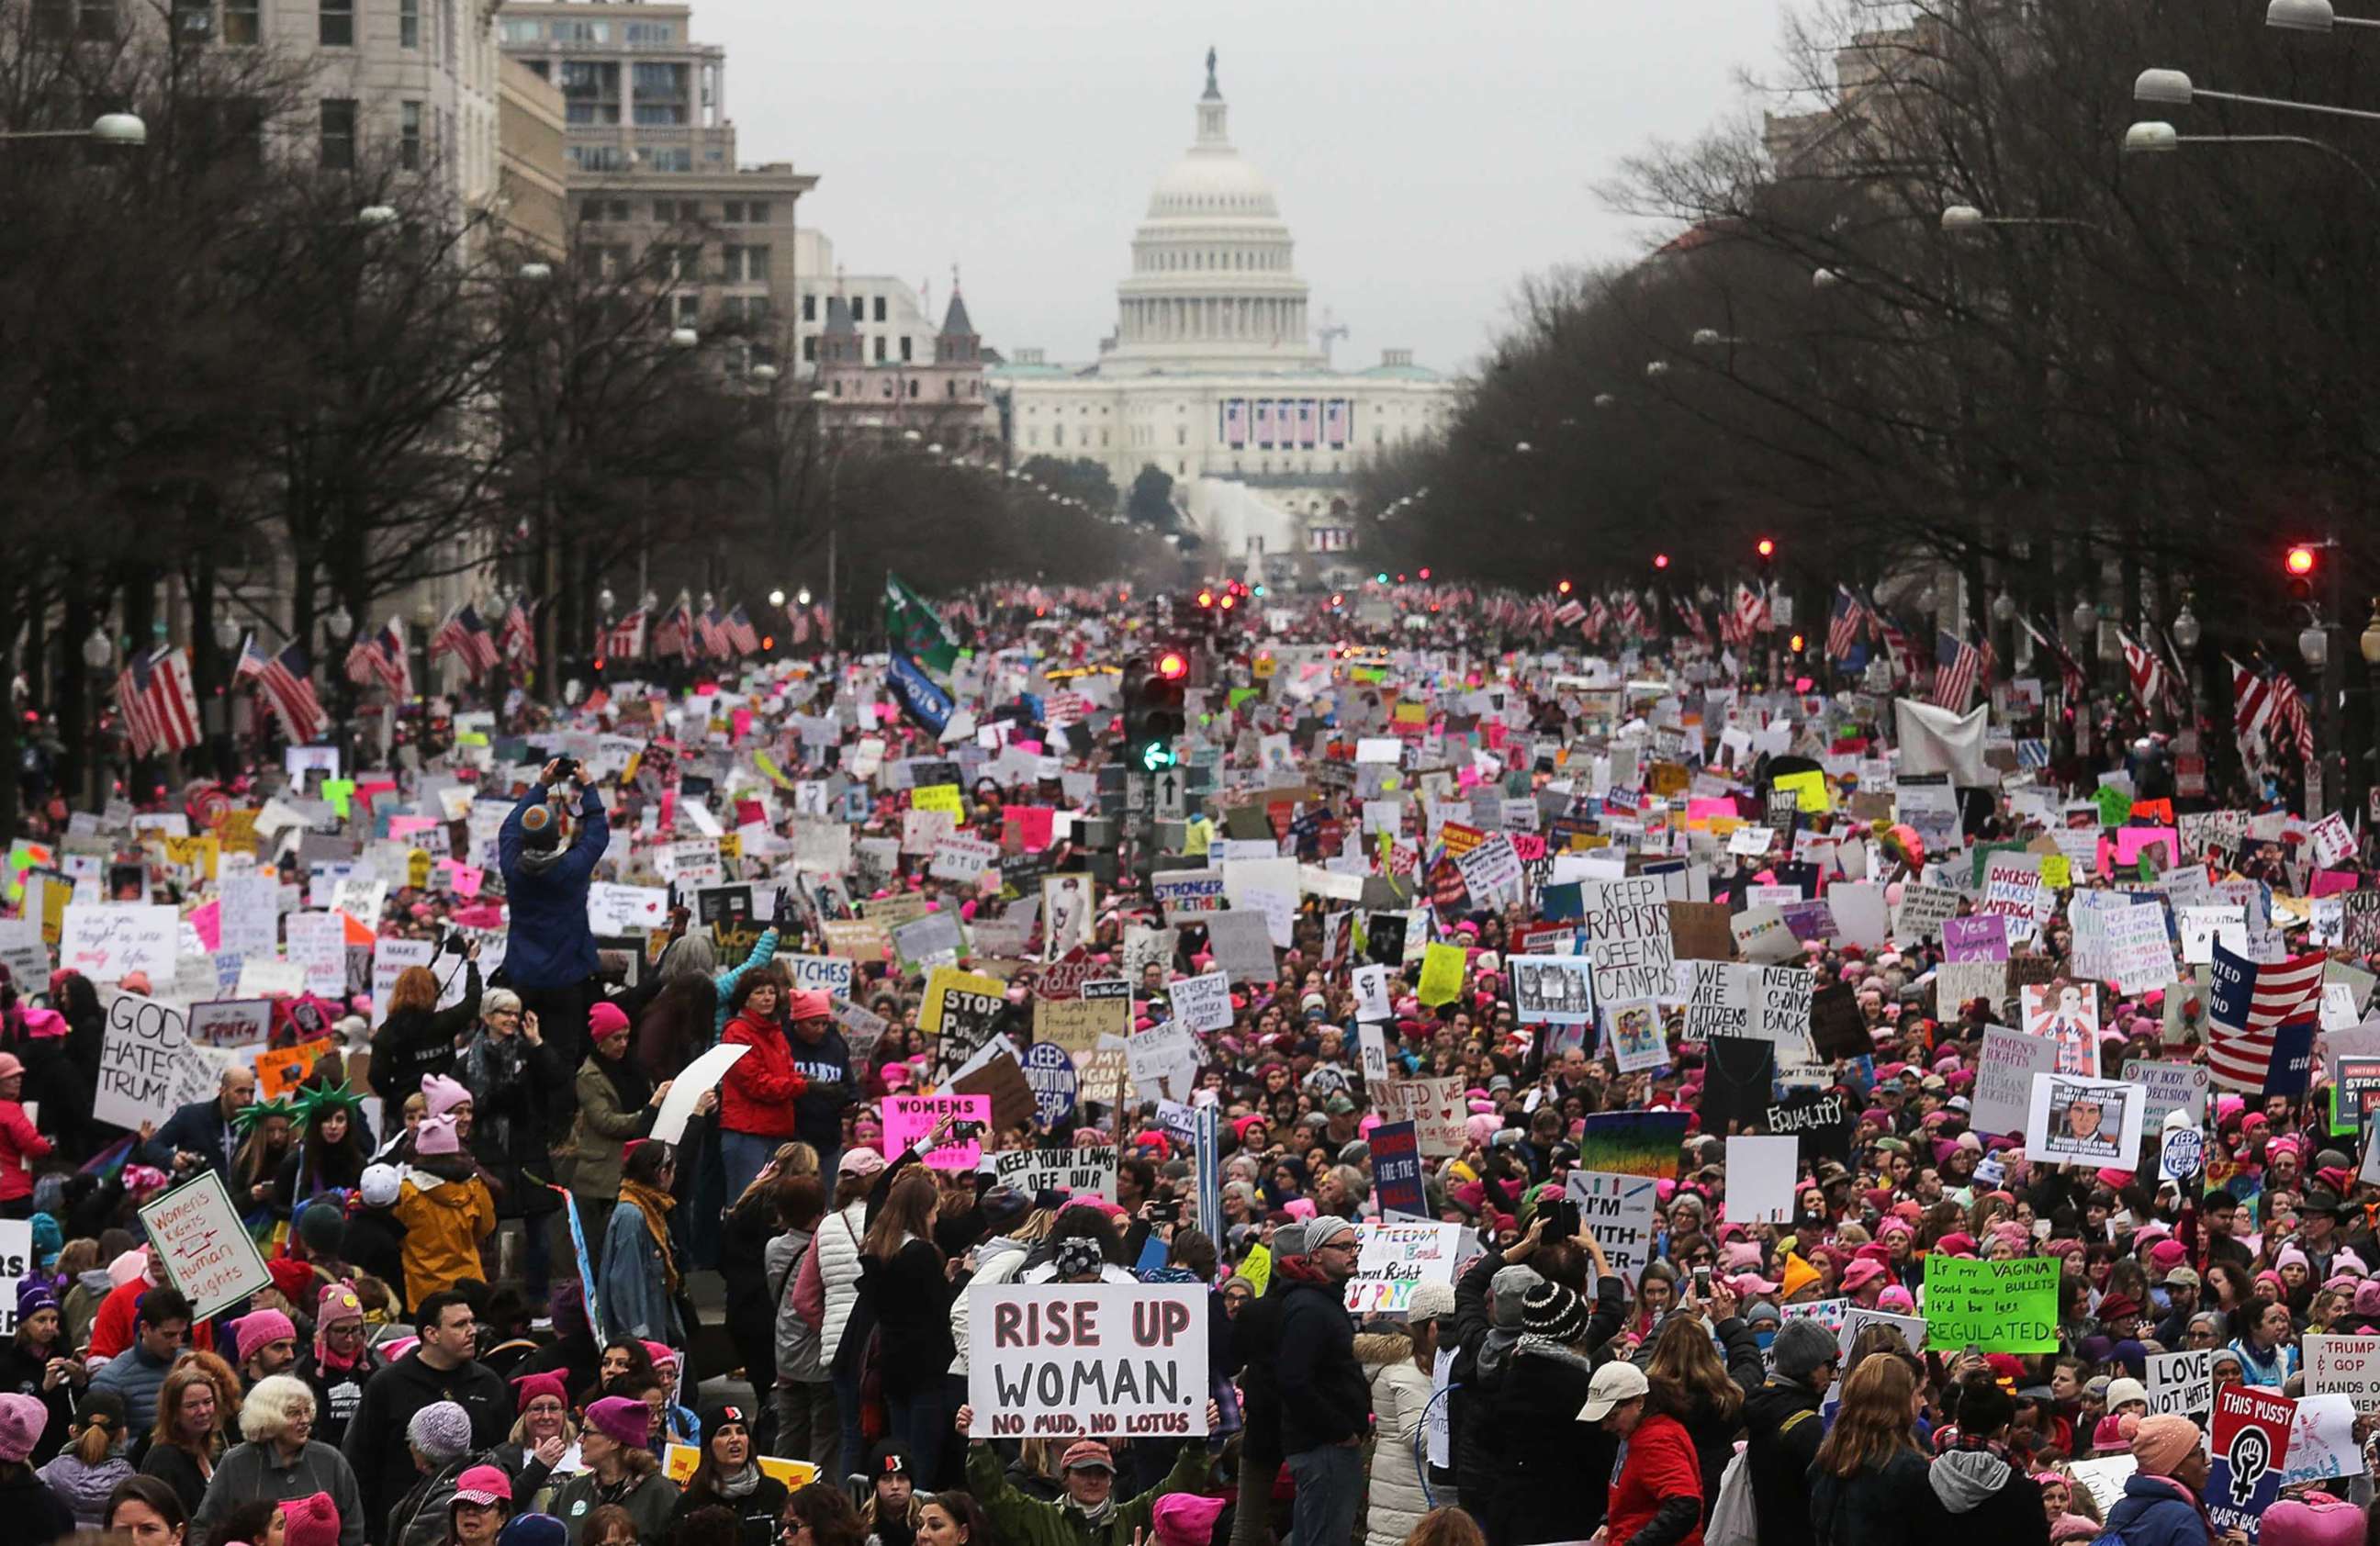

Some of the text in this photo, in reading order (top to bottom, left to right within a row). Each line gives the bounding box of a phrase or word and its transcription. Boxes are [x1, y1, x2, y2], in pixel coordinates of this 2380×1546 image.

[1770, 792, 1795, 809] NO!
[1991, 867, 2040, 887] DIVERSITY
[1154, 879, 1224, 900] STRONGER
[1600, 879, 1654, 909] KEEP
[1991, 885, 2035, 902] MAKES
[1984, 899, 2034, 920] AMERICA
[1586, 903, 1669, 940] RAPISTS
[1956, 920, 1989, 936] Yes
[2005, 919, 2028, 935] EAT
[386, 946, 421, 958] MAKE
[1596, 937, 1671, 967] OFF MY
[1948, 935, 2004, 950] Women
[1959, 949, 1993, 962] CAN
[788, 958, 850, 983] TCHES
[1695, 961, 1729, 988] WE
[1762, 968, 1814, 991] NEVER
[2212, 957, 2241, 984] ITED
[1086, 986, 1100, 996] Yes
[1598, 966, 1677, 1001] CAMPUS
[944, 990, 1003, 1015] STOP
[1691, 986, 1726, 1005] ARE
[110, 996, 185, 1048] GOD
[1690, 1004, 1747, 1027] CITIZENS
[1763, 1009, 1807, 1038] BACK
[1987, 1034, 2038, 1055] WOMEN'S
[1028, 1045, 1065, 1068] KEEP
[1095, 1051, 1123, 1066] MY
[1985, 1047, 2029, 1069] RIGHTS
[1981, 1073, 2026, 1092] HUMAN
[2140, 1070, 2186, 1085] MY BODY
[1439, 1081, 1463, 1103] WE
[1981, 1088, 2025, 1106] RIGHTS
[2146, 1086, 2193, 1103] DECISION
[897, 1100, 975, 1115] WOMENS
[1035, 1092, 1070, 1118] EGAL
[1396, 1108, 1432, 1121] SND
[1766, 1093, 1842, 1133] EQUALITY
[1158, 1110, 1180, 1125] DO
[903, 1136, 969, 1150] HAN
[2174, 1130, 2198, 1145] KEEP
[995, 1147, 1117, 1176] KEEP YOUR LAWS
[1027, 1171, 1102, 1192] OFF OUR
[1586, 1196, 1621, 1216] I'M
[164, 1214, 207, 1243] RIGHTS
[176, 1241, 236, 1281] Human
[1603, 1250, 1630, 1270] ER
[1933, 1259, 1948, 1275] If
[1991, 1261, 2050, 1279] VAGINA
[190, 1267, 243, 1302] Rights
[2005, 1279, 2055, 1294] BULLETS
[1782, 1302, 1836, 1320] STANDING
[1968, 1300, 1982, 1313] be
[995, 1301, 1190, 1348] RISE UP
[1926, 1321, 2049, 1341] REGULATED
[2325, 1341, 2375, 1353] TRUMP
[2158, 1353, 2210, 1385] LOVE
[2334, 1360, 2365, 1372] GOP
[994, 1359, 1192, 1406] WOMAN.
[2316, 1381, 2364, 1394] HANDS
[2149, 1382, 2210, 1416] NOT HATE
[2222, 1392, 2294, 1426] THIS PUSSY
[992, 1412, 1190, 1435] NO MUD, NO LOTUS
[2207, 1504, 2238, 1527] RABS
